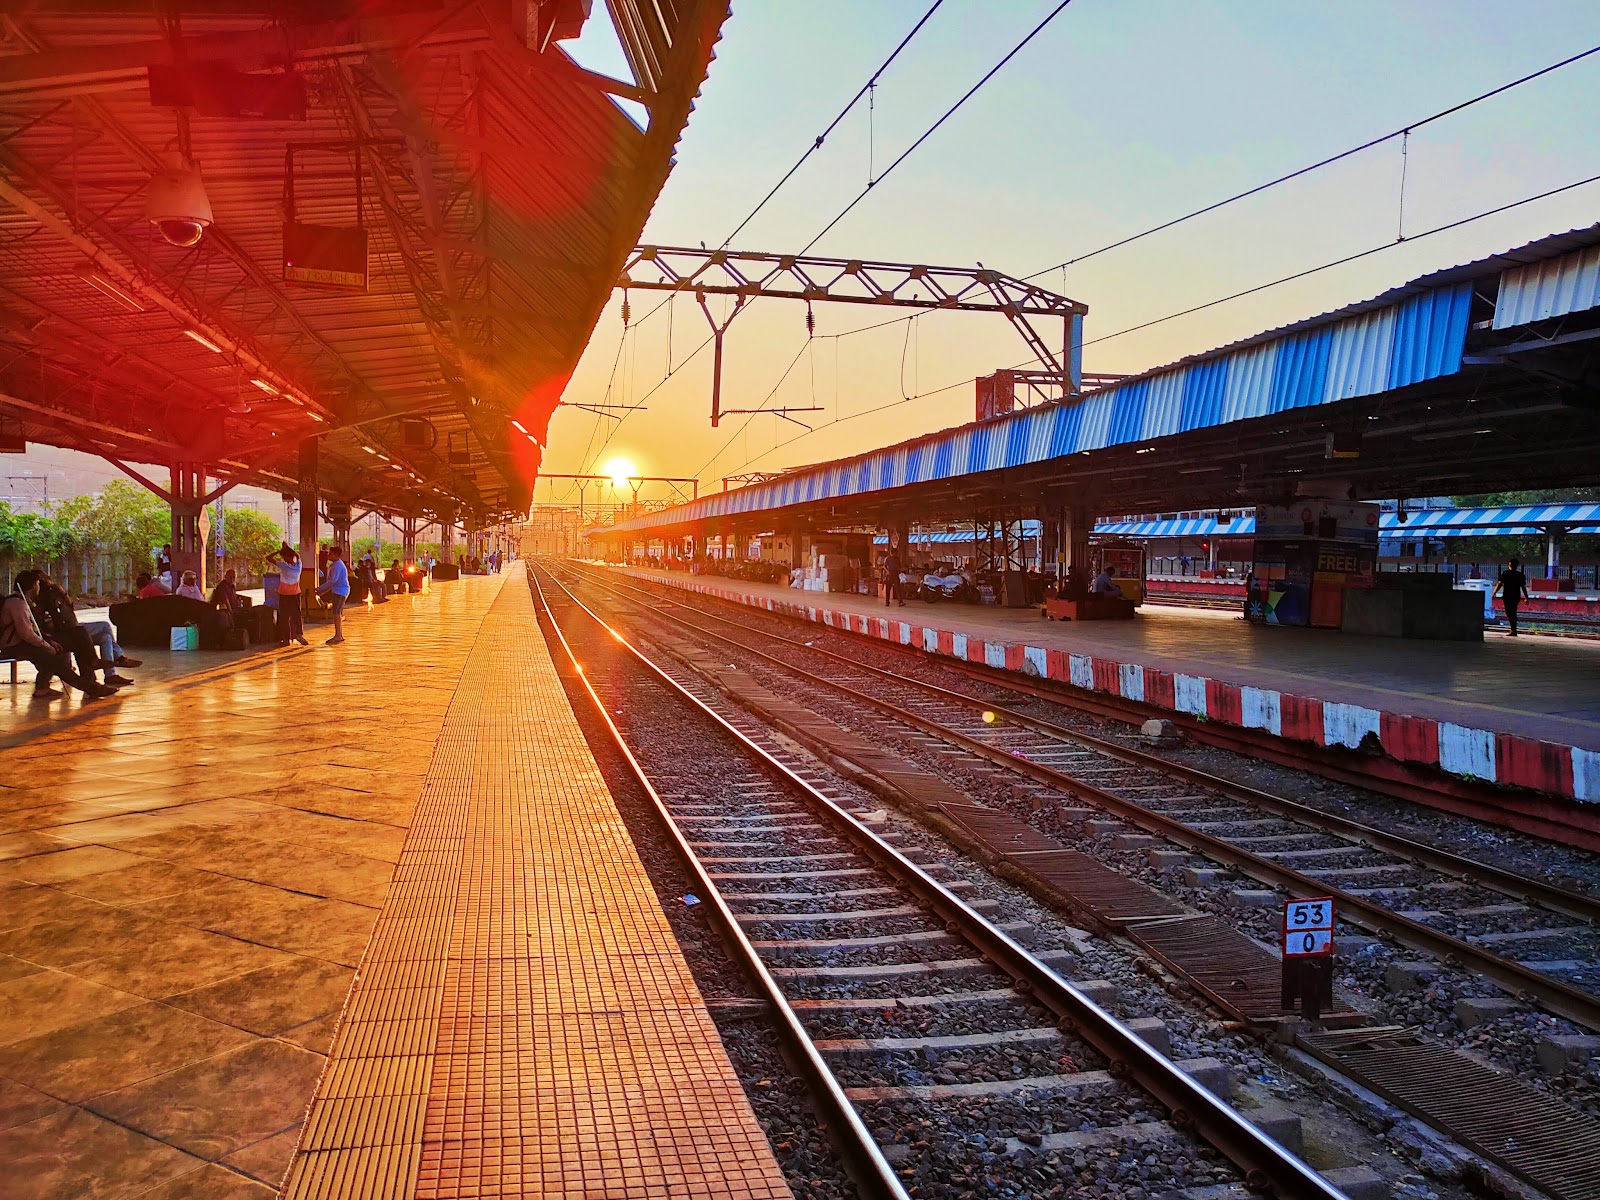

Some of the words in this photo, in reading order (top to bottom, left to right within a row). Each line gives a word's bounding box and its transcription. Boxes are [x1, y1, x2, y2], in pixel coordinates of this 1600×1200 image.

[1317, 555, 1357, 572] FREE!
[1293, 904, 1324, 925] 53
[1303, 933, 1315, 952] 0
